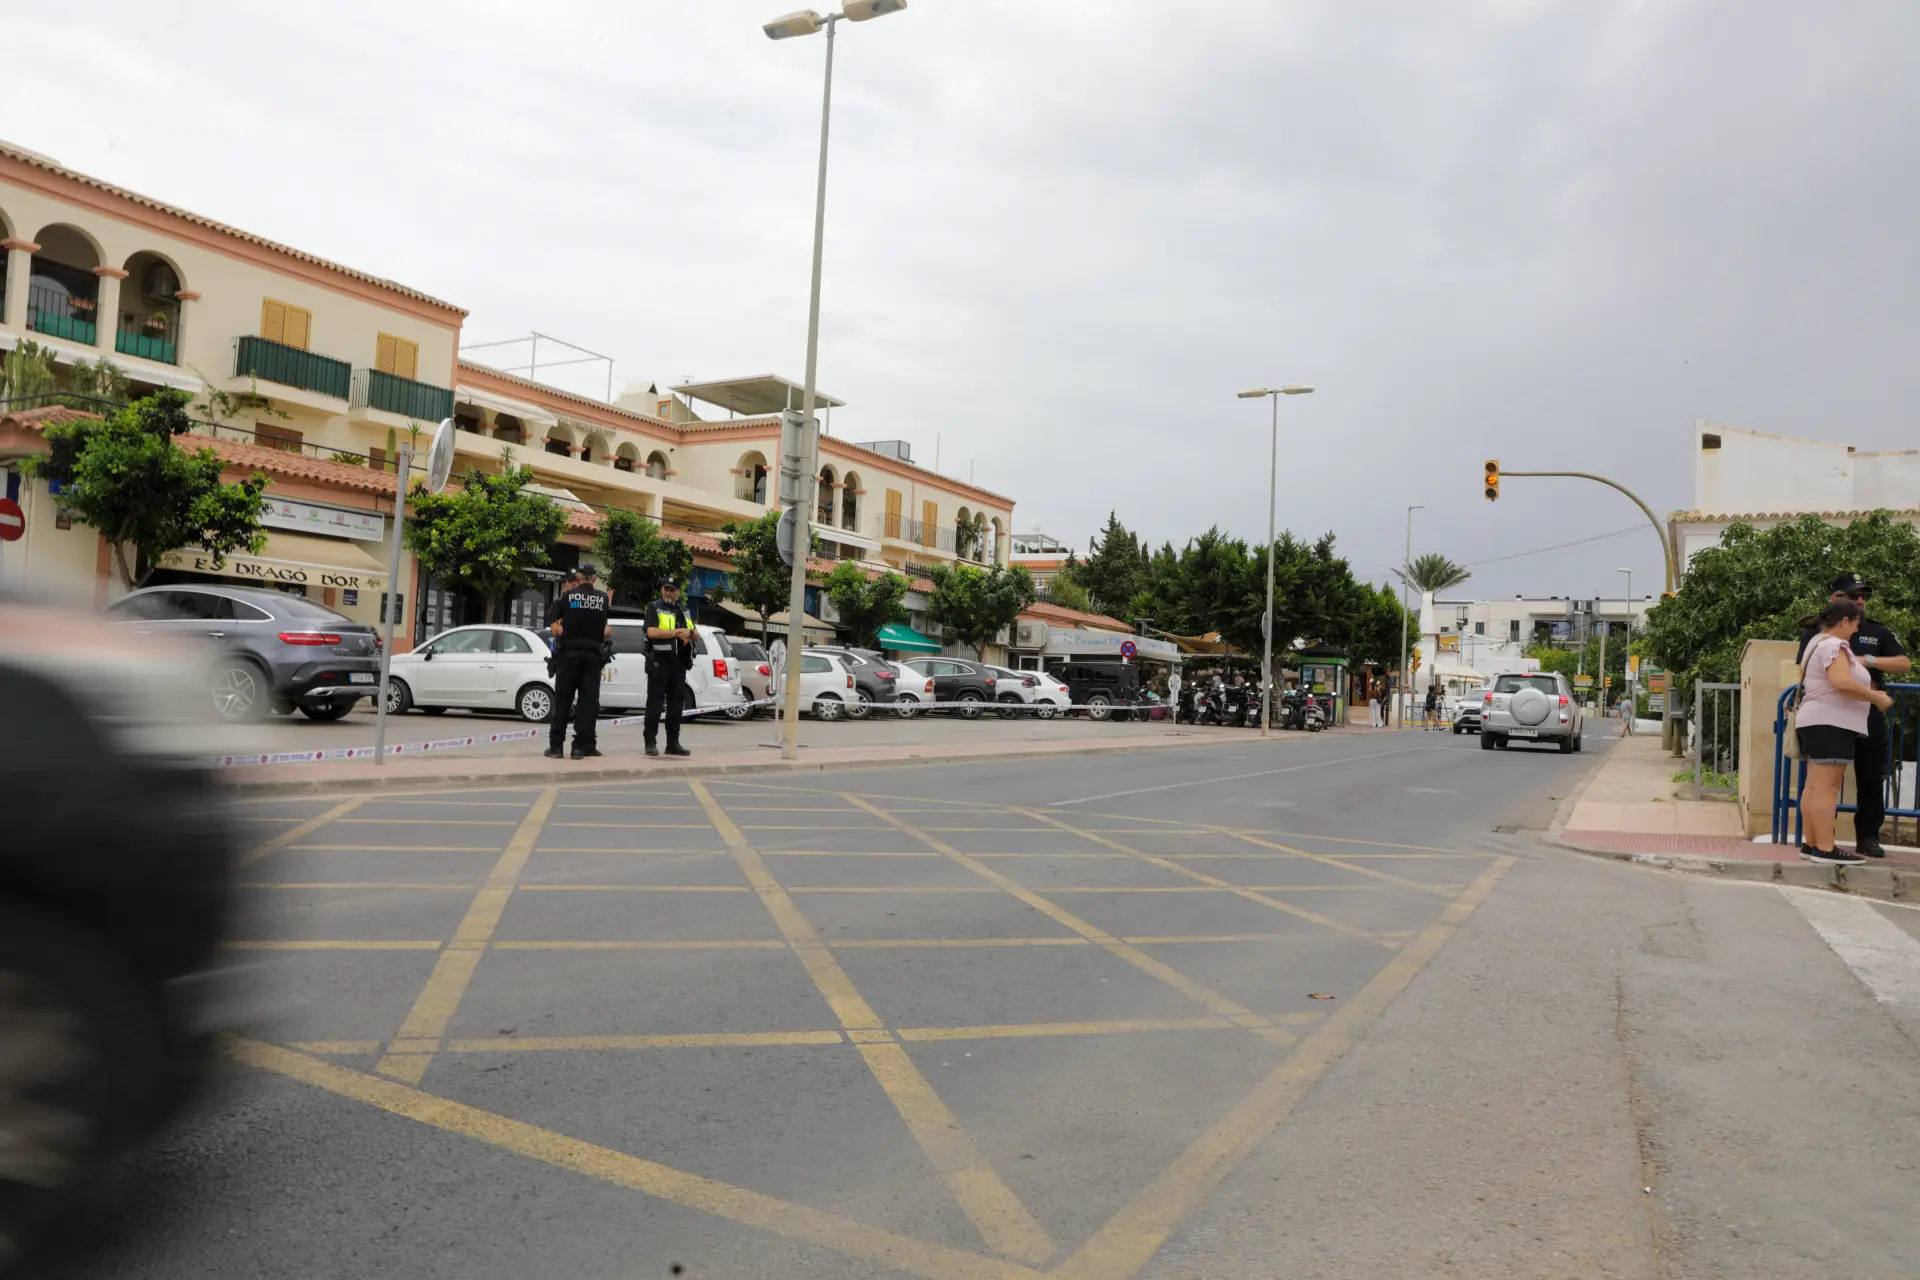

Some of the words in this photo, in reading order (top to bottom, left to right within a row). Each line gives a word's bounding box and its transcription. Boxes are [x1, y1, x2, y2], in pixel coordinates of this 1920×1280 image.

[194, 557, 224, 571] ES
[235, 562, 308, 582] DRAGÓ
[568, 593, 604, 604] POLICIA
[579, 601, 604, 611] LOCAL
